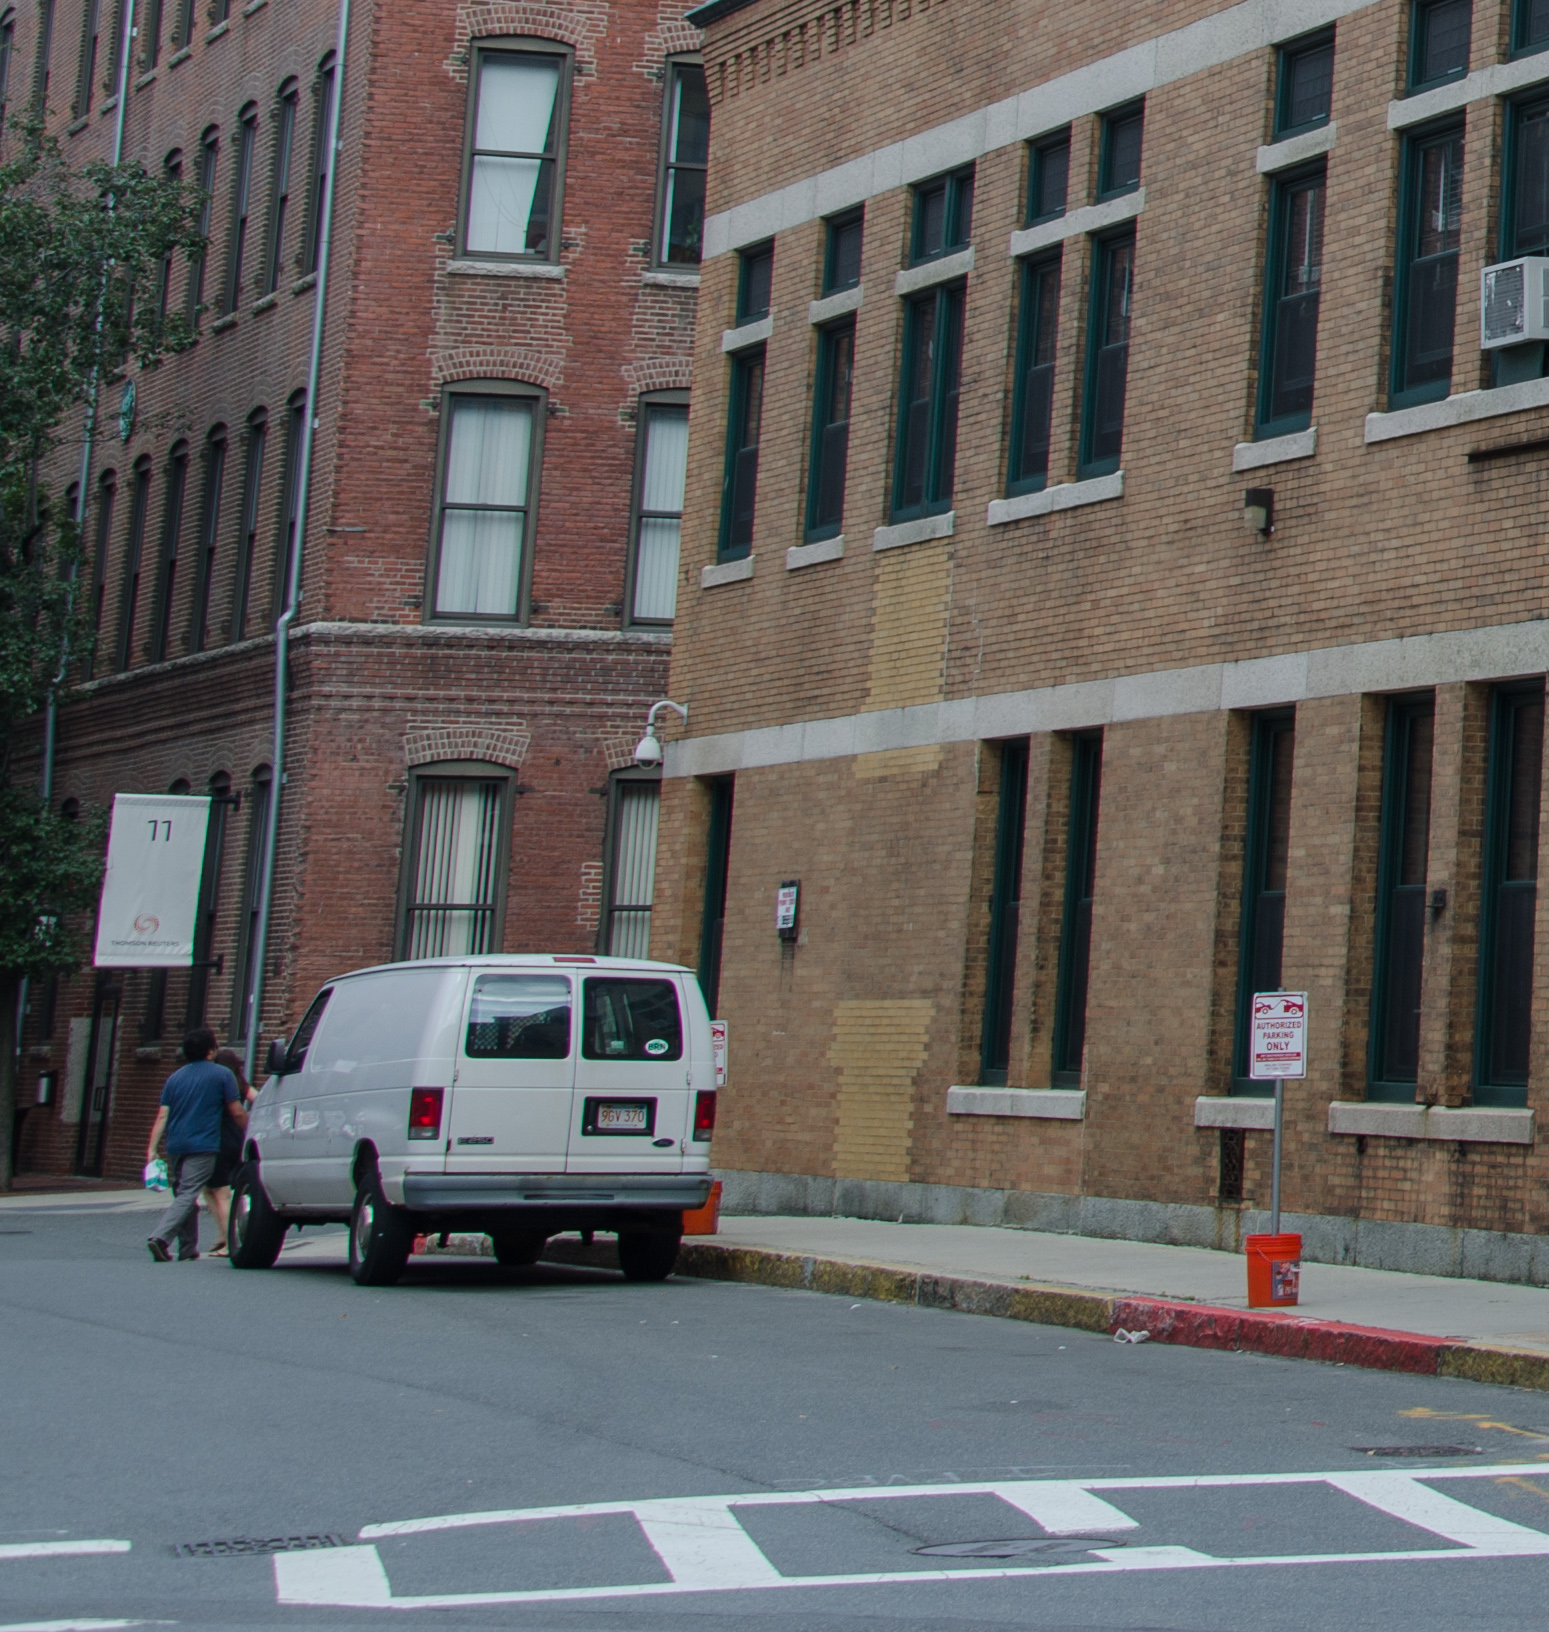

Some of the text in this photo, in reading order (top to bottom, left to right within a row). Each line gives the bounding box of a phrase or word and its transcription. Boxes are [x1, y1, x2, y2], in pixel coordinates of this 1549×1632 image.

[147, 819, 172, 842] 11
[1257, 1021, 1301, 1029] AUTHORIZED
[1263, 1031, 1294, 1039] PARKING
[1266, 1041, 1290, 1051] ONLY
[601, 1110, 644, 1122] 9GV 370
